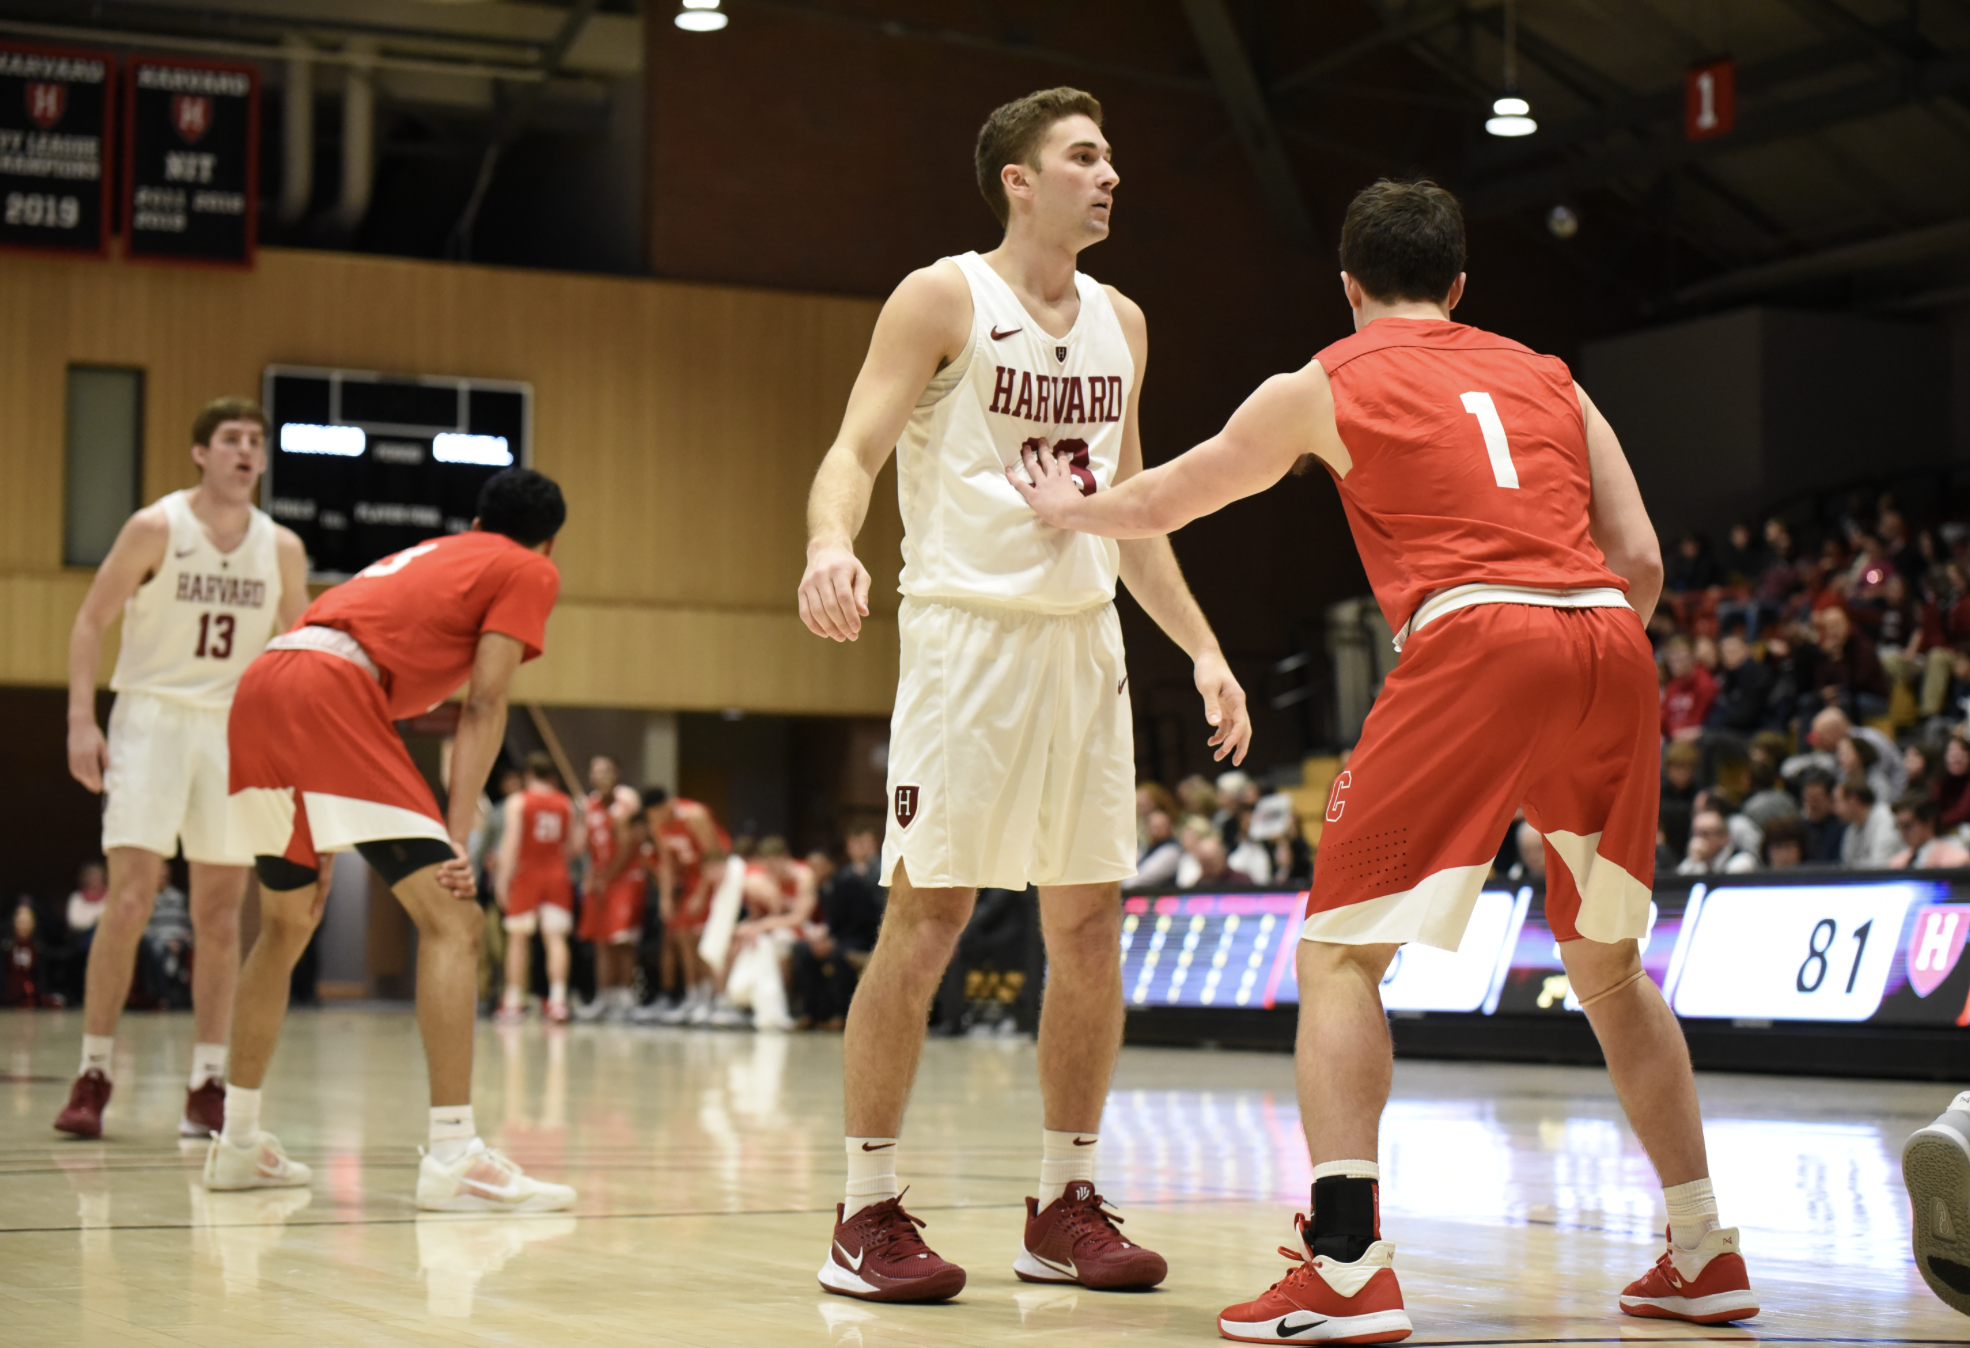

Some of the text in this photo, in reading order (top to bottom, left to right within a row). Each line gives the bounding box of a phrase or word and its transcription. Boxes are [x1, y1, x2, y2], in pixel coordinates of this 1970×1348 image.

[138, 65, 249, 96] HARVARD
[1696, 71, 1719, 129] 1
[164, 151, 216, 183] NIT
[4, 191, 80, 228] 2019
[989, 365, 1122, 424] HARVARD
[1459, 391, 1520, 489] 1
[176, 572, 265, 609] HARVARD
[194, 611, 235, 659] 13
[897, 789, 911, 816] H
[1326, 770, 1352, 822] C
[1796, 918, 1874, 994] 81
[1914, 913, 1960, 971] H
